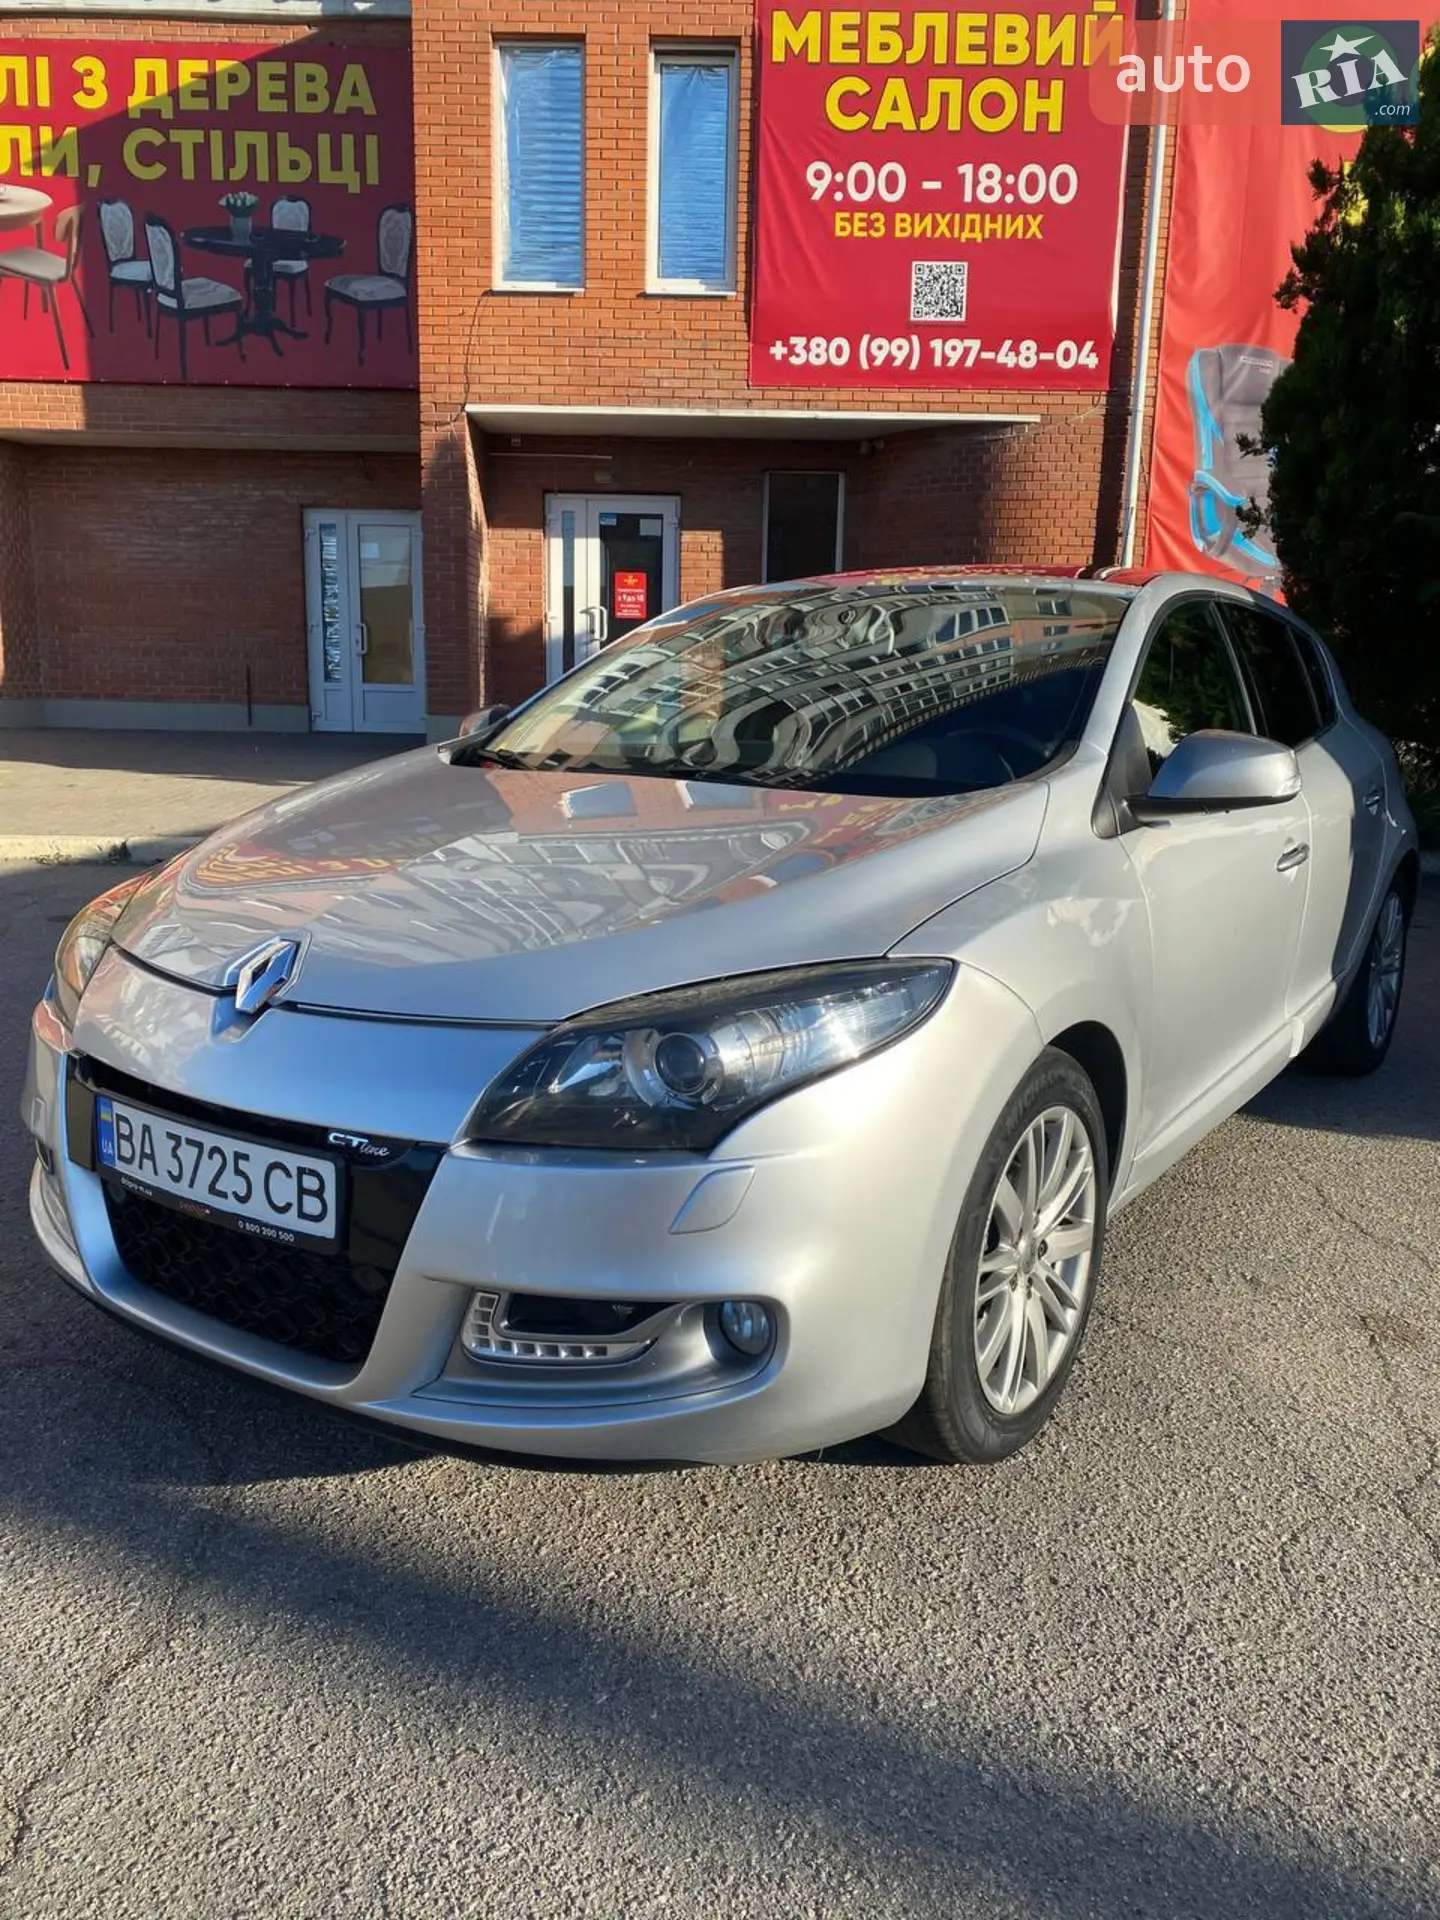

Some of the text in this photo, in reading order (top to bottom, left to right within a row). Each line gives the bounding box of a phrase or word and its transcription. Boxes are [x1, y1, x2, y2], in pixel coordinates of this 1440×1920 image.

[772, 1, 1124, 66] МЕБЛЕВИЙ
[127, 57, 378, 120] ДЕРЕВА
[825, 76, 1064, 132] САЛОН
[122, 127, 380, 194] СТІЛЬЦІ
[805, 161, 906, 203] 9:00
[957, 163, 1078, 204] 18:00
[834, 212, 1044, 242] БЕЗ ВИХІДНИХ
[769, 334, 1098, 371] +380 (99) 197-48-04
[101, 1139, 115, 1155] UA
[114, 1113, 329, 1223] BA 3725 CB
